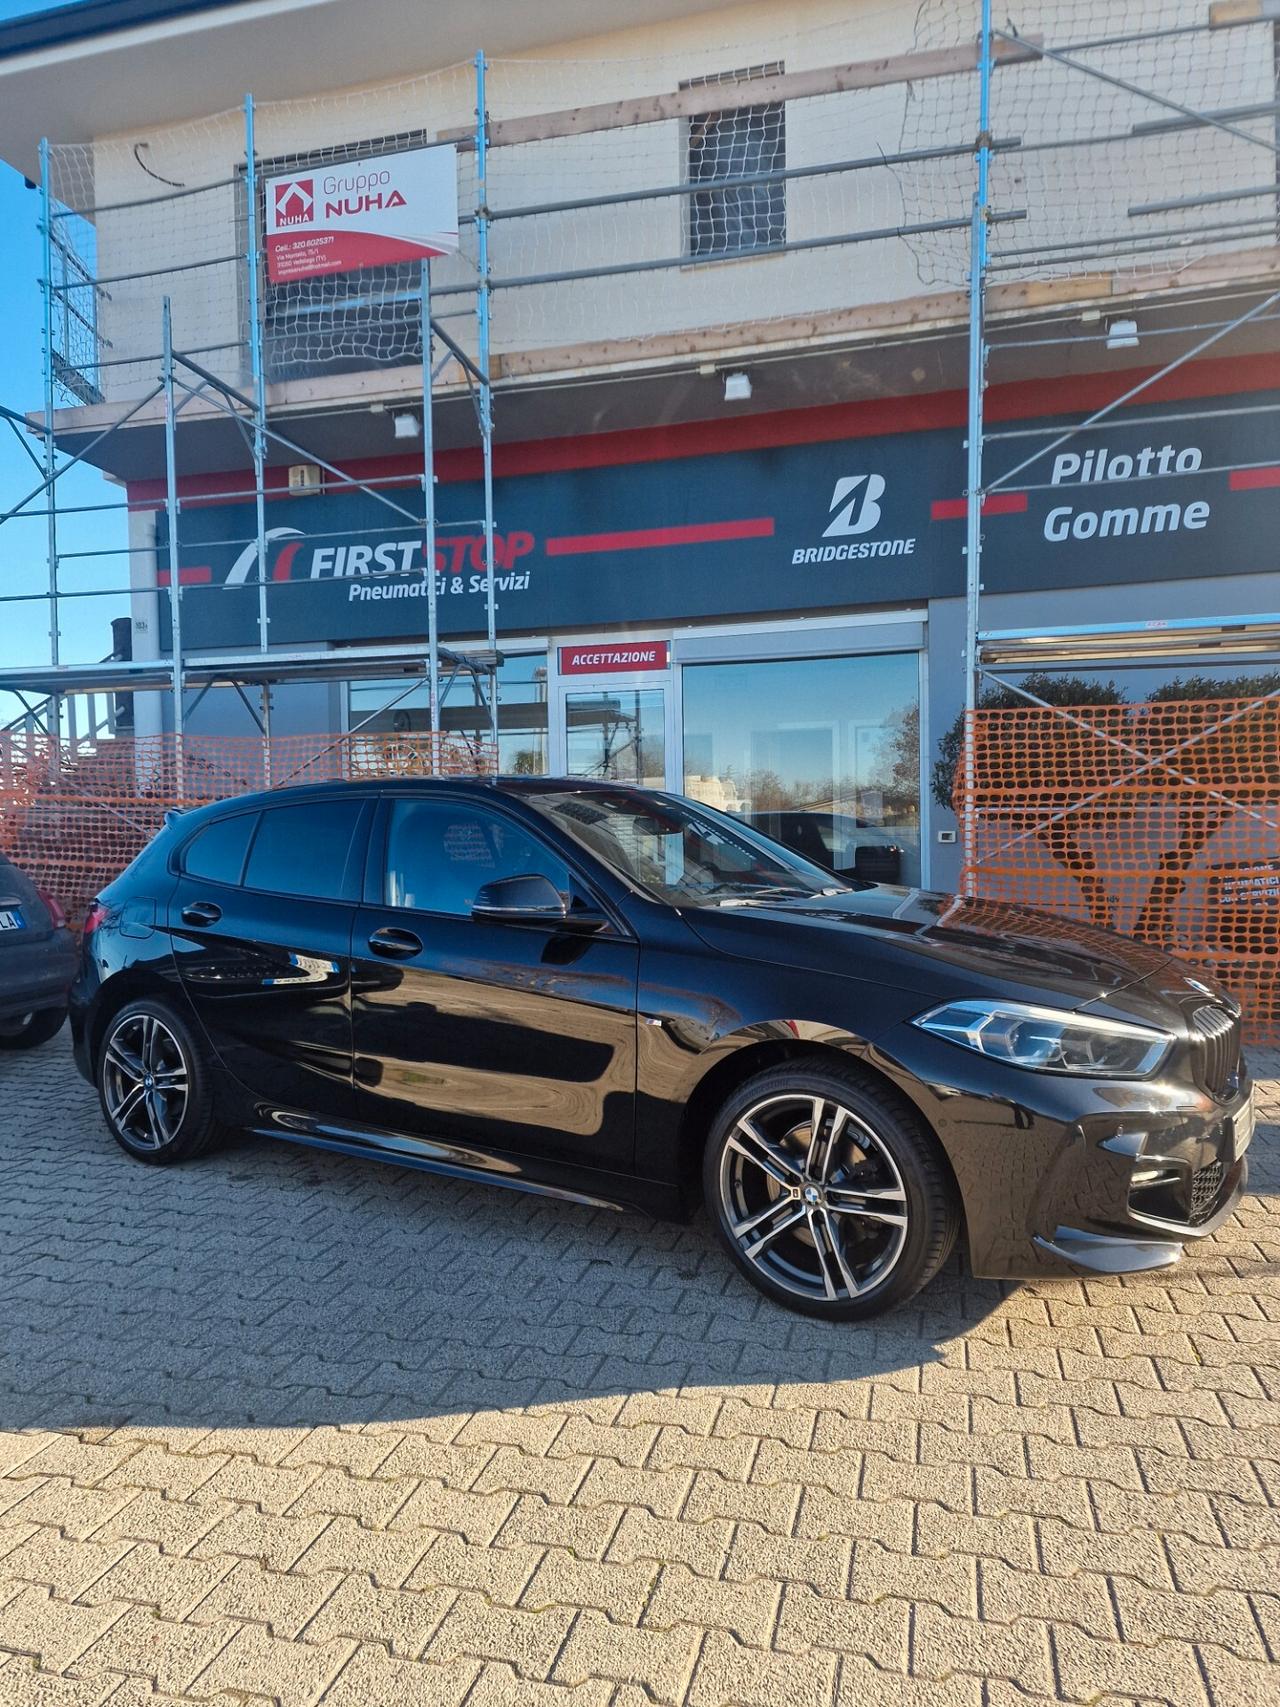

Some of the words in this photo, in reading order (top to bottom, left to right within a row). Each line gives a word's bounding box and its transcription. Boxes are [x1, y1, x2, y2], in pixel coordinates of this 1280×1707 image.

[323, 170, 390, 194] Gruppo
[325, 190, 407, 219] NUHA
[279, 214, 310, 226] NUHA
[1051, 445, 1202, 485] Pilotto
[1044, 501, 1210, 542] Gomme
[792, 538, 916, 564] BRIDGESTONE
[349, 577, 446, 601] Pneumati
[450, 576, 464, 594] &
[572, 650, 656, 665] ACCETTAZIONE
